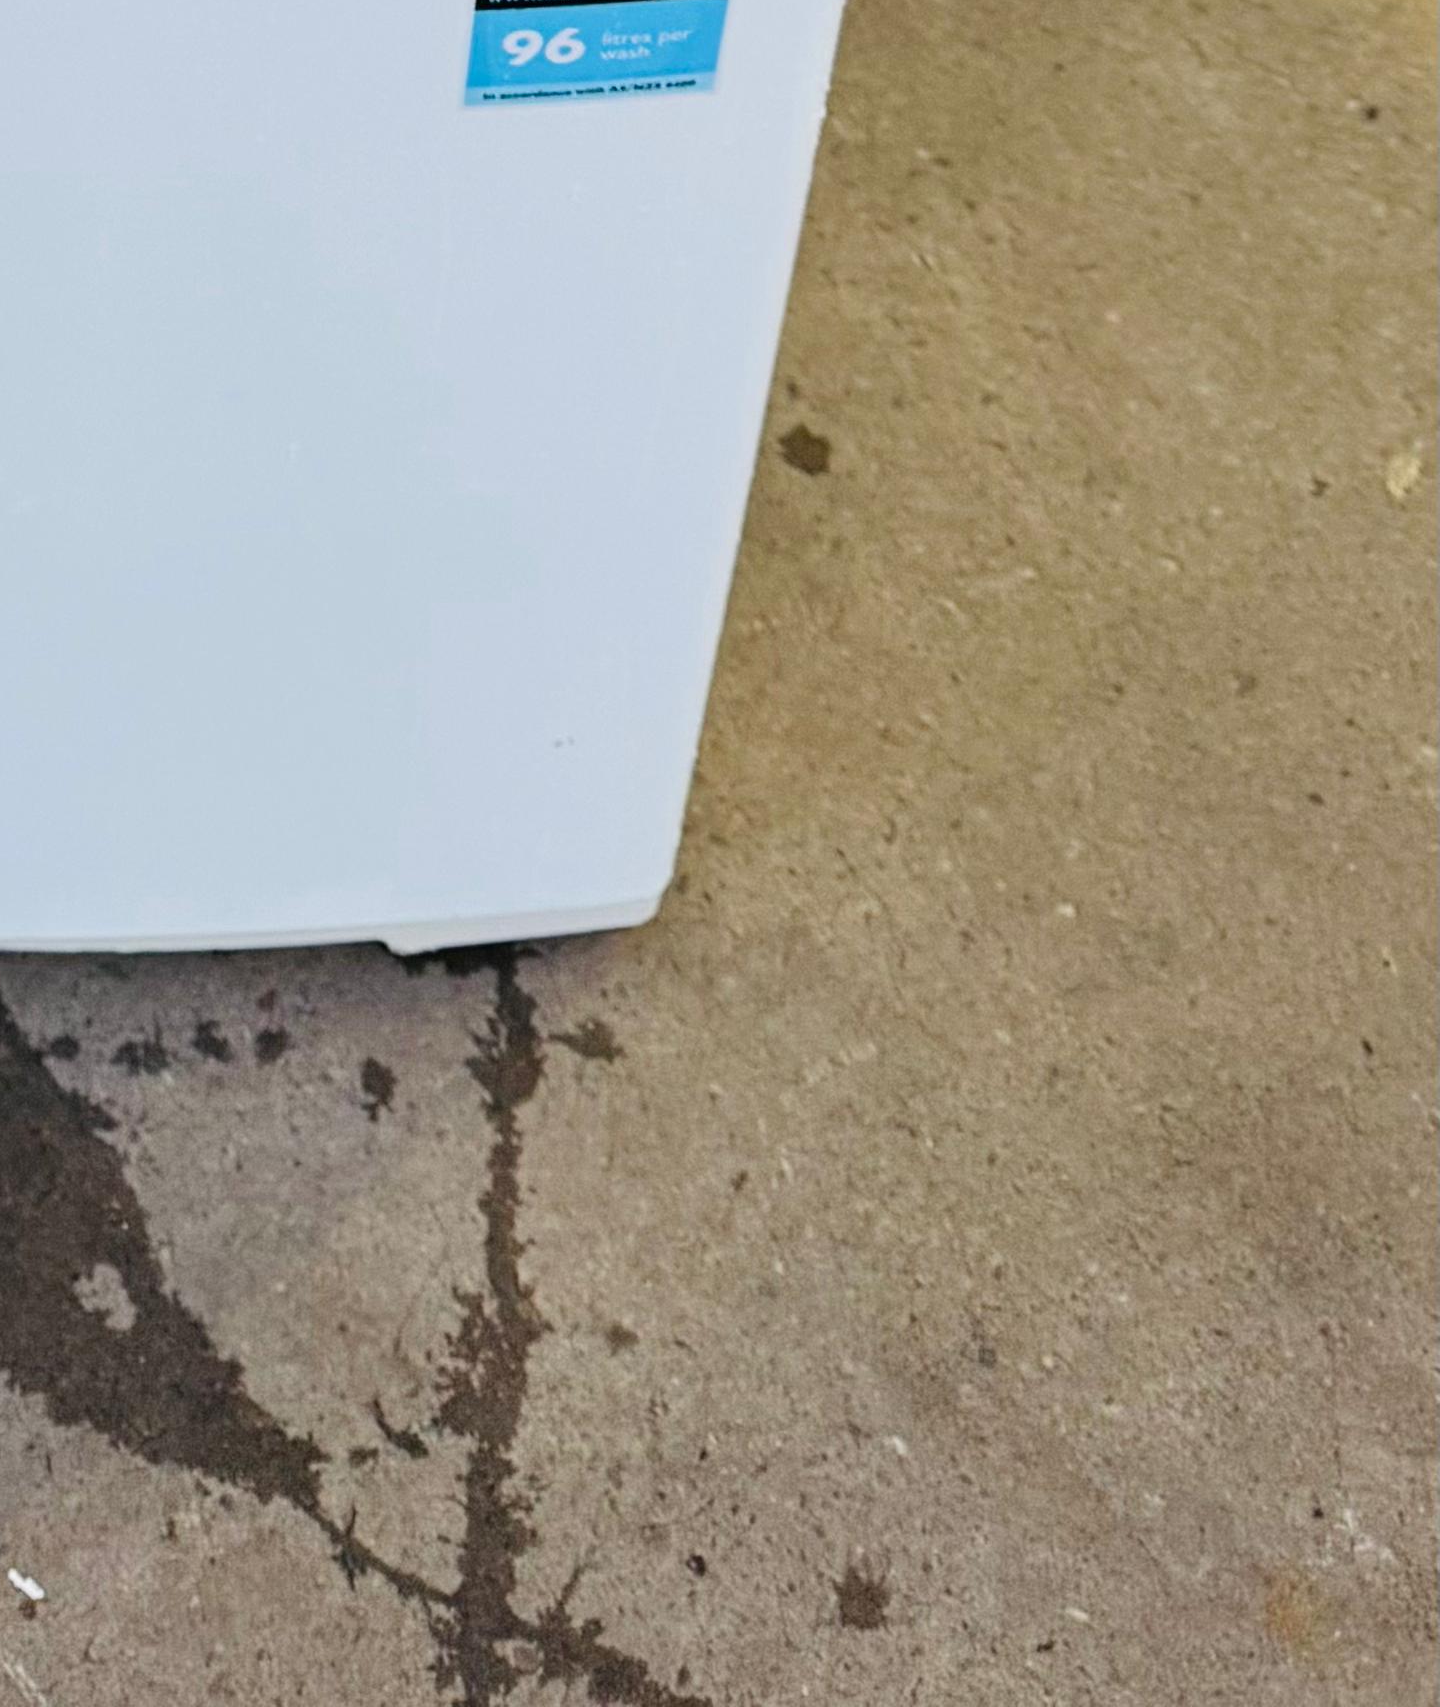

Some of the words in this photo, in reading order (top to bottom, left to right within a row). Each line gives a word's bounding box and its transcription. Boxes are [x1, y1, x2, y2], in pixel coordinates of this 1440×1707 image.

[602, 30, 652, 46] litres
[657, 29, 693, 47] per
[501, 27, 586, 68] 96
[600, 46, 652, 61] wash
